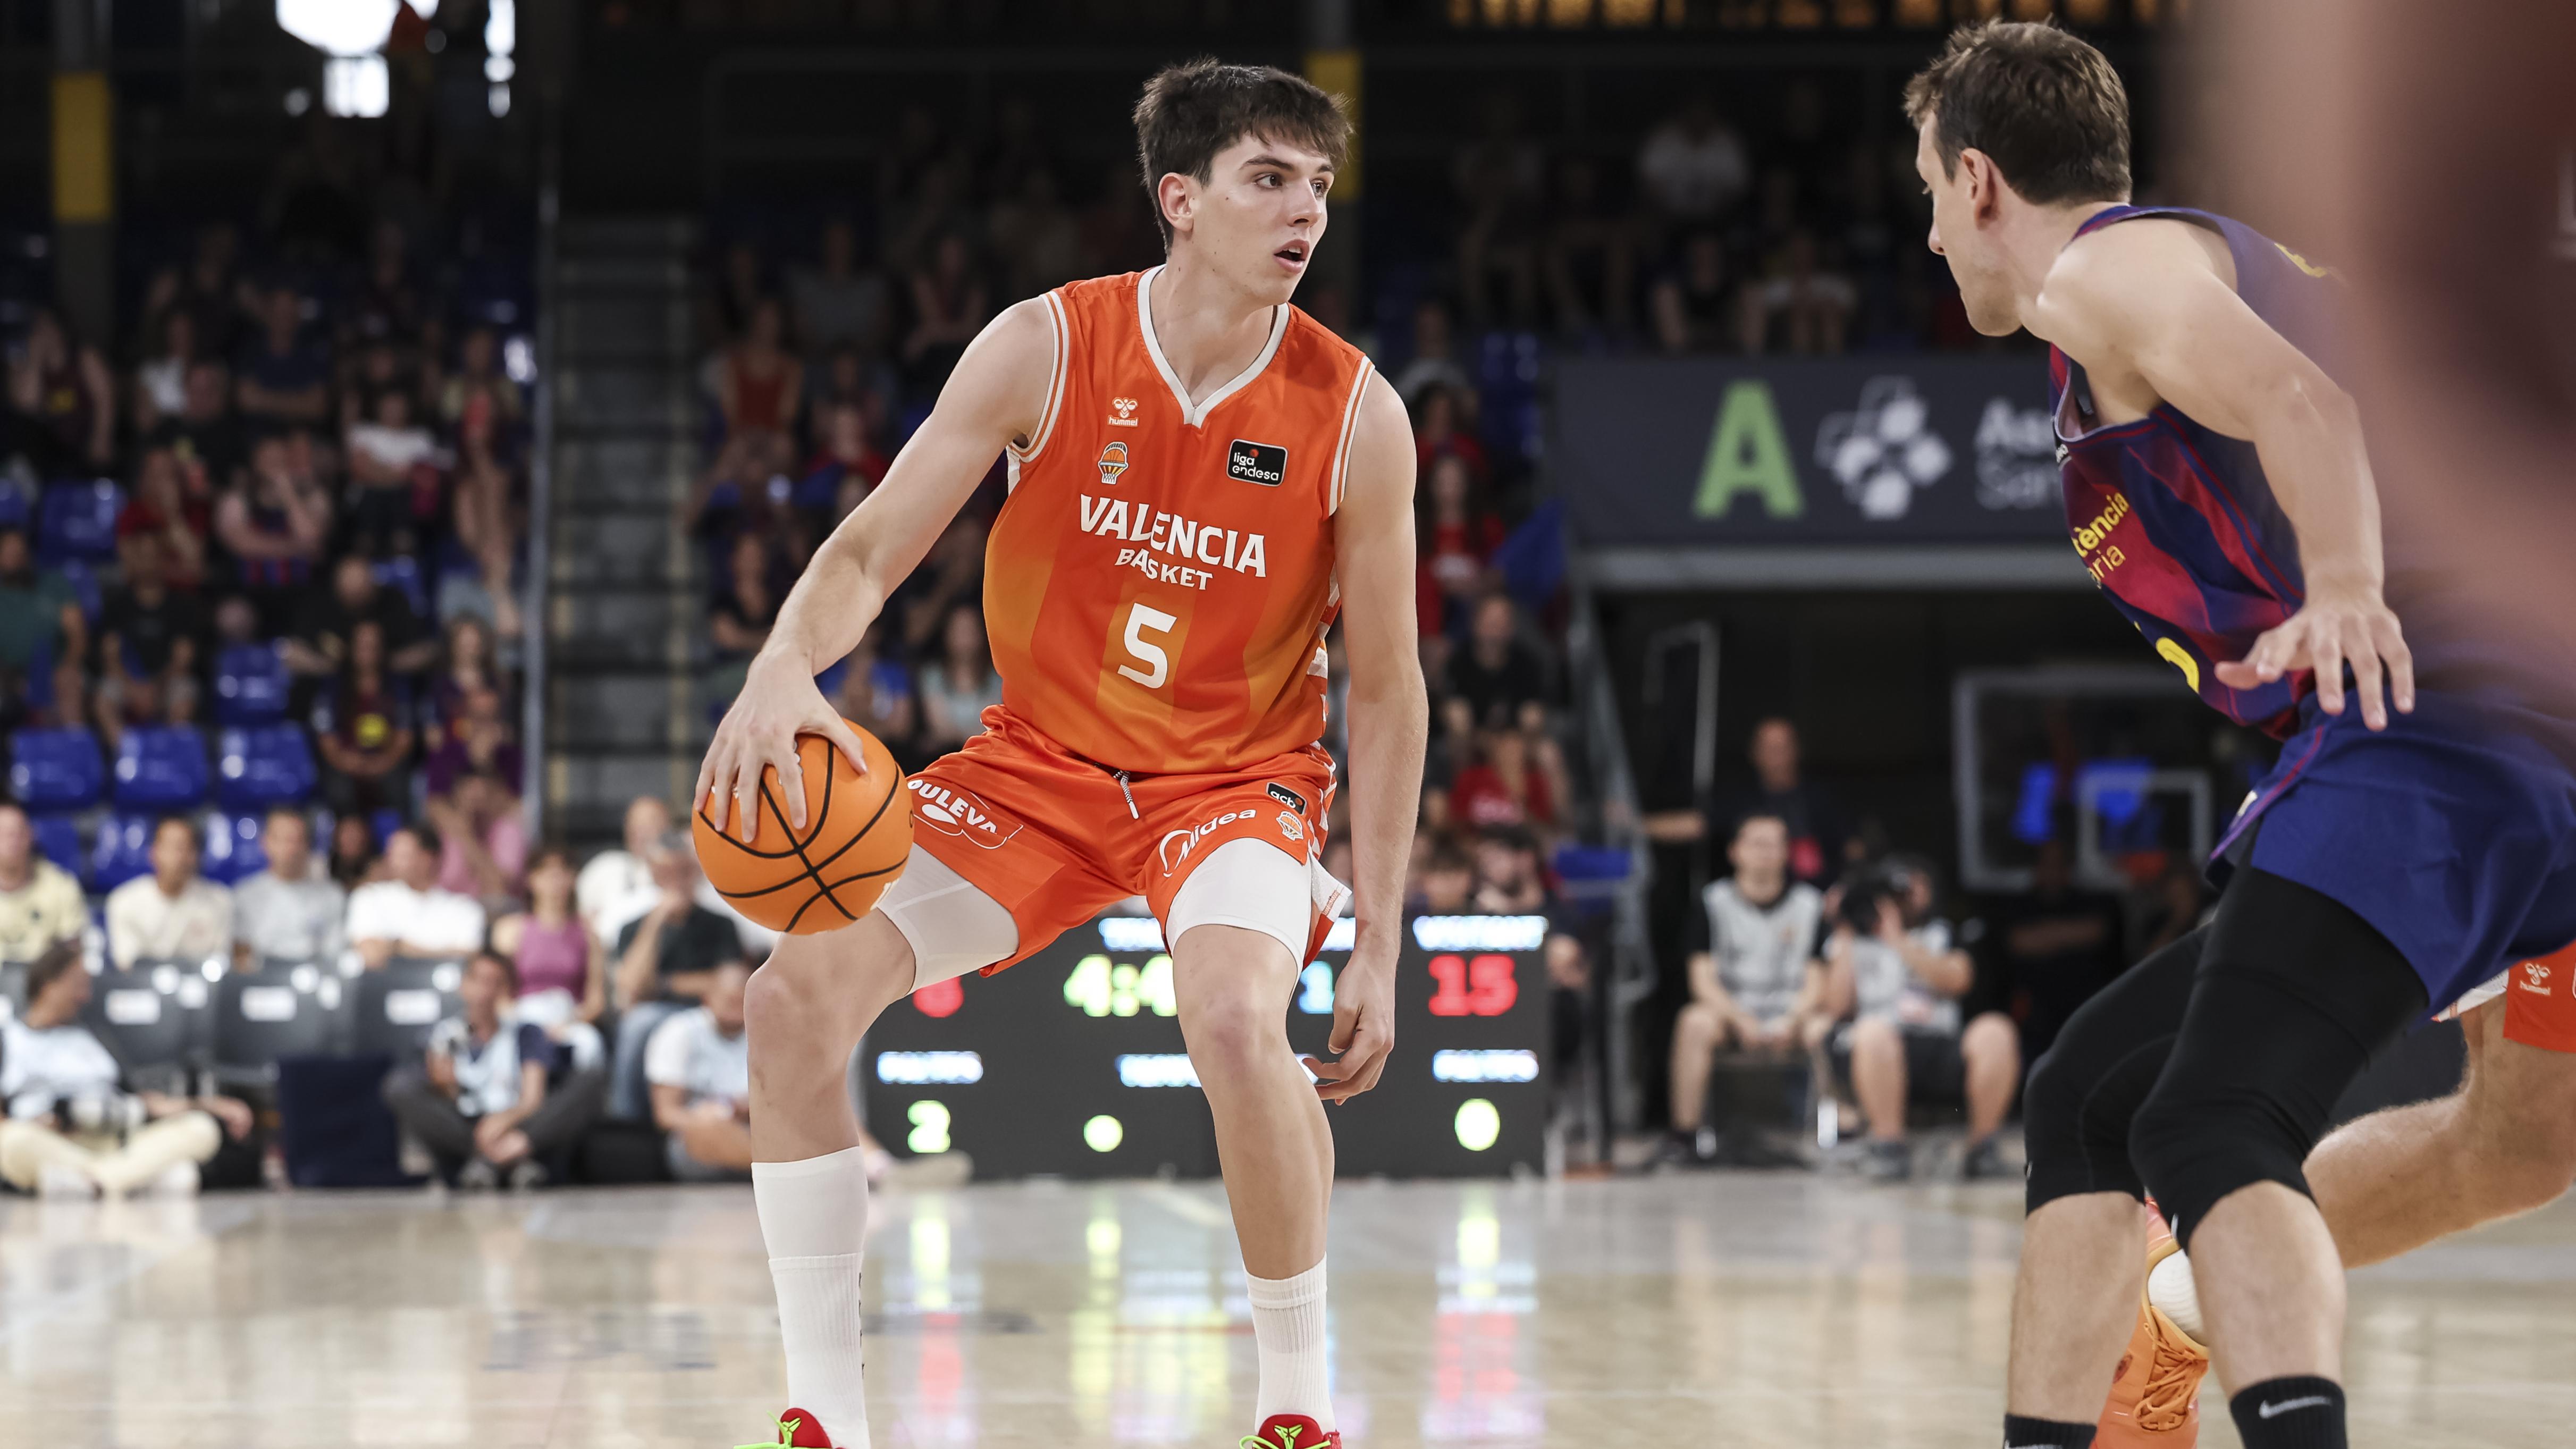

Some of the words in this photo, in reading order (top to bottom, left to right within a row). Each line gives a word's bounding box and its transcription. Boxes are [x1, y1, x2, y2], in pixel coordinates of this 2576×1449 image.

[1108, 416, 1138, 426] hummel
[1232, 465, 1279, 481] endesa
[1233, 452, 1255, 466] liga
[1695, 380, 1803, 518] A
[1080, 493, 1266, 578] VALENCIA
[1114, 548, 1213, 590] BASKET
[1117, 602, 1177, 689] 5
[1270, 790, 1296, 809] acb
[1169, 809, 1257, 871] Midea
[1428, 954, 1519, 1016] 15
